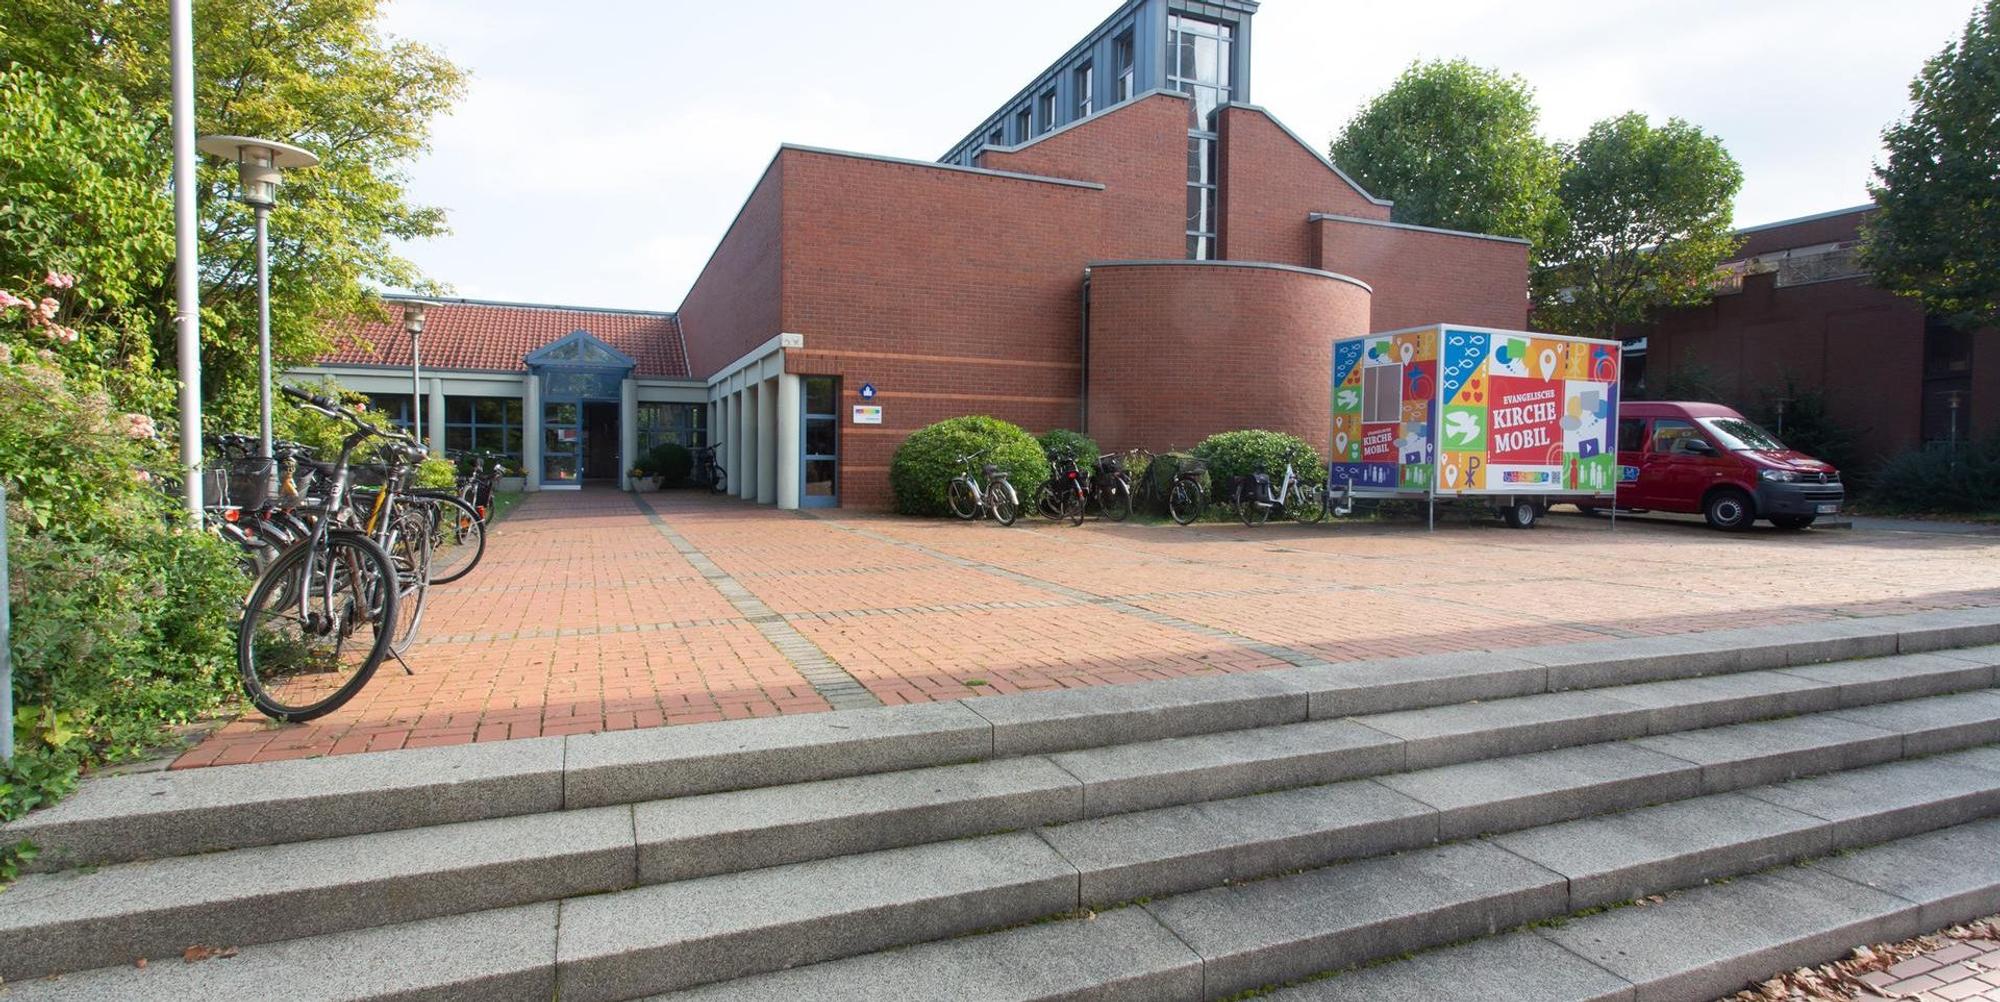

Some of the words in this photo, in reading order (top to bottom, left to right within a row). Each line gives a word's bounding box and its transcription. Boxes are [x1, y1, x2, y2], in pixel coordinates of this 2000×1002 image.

[1503, 389, 1555, 404] EVANGELISCHE
[1493, 402, 1556, 429] KIRCHE
[1363, 432, 1393, 446] KIRCHE
[1494, 427, 1550, 454] MOBIL
[1364, 443, 1390, 456] MOBIL
